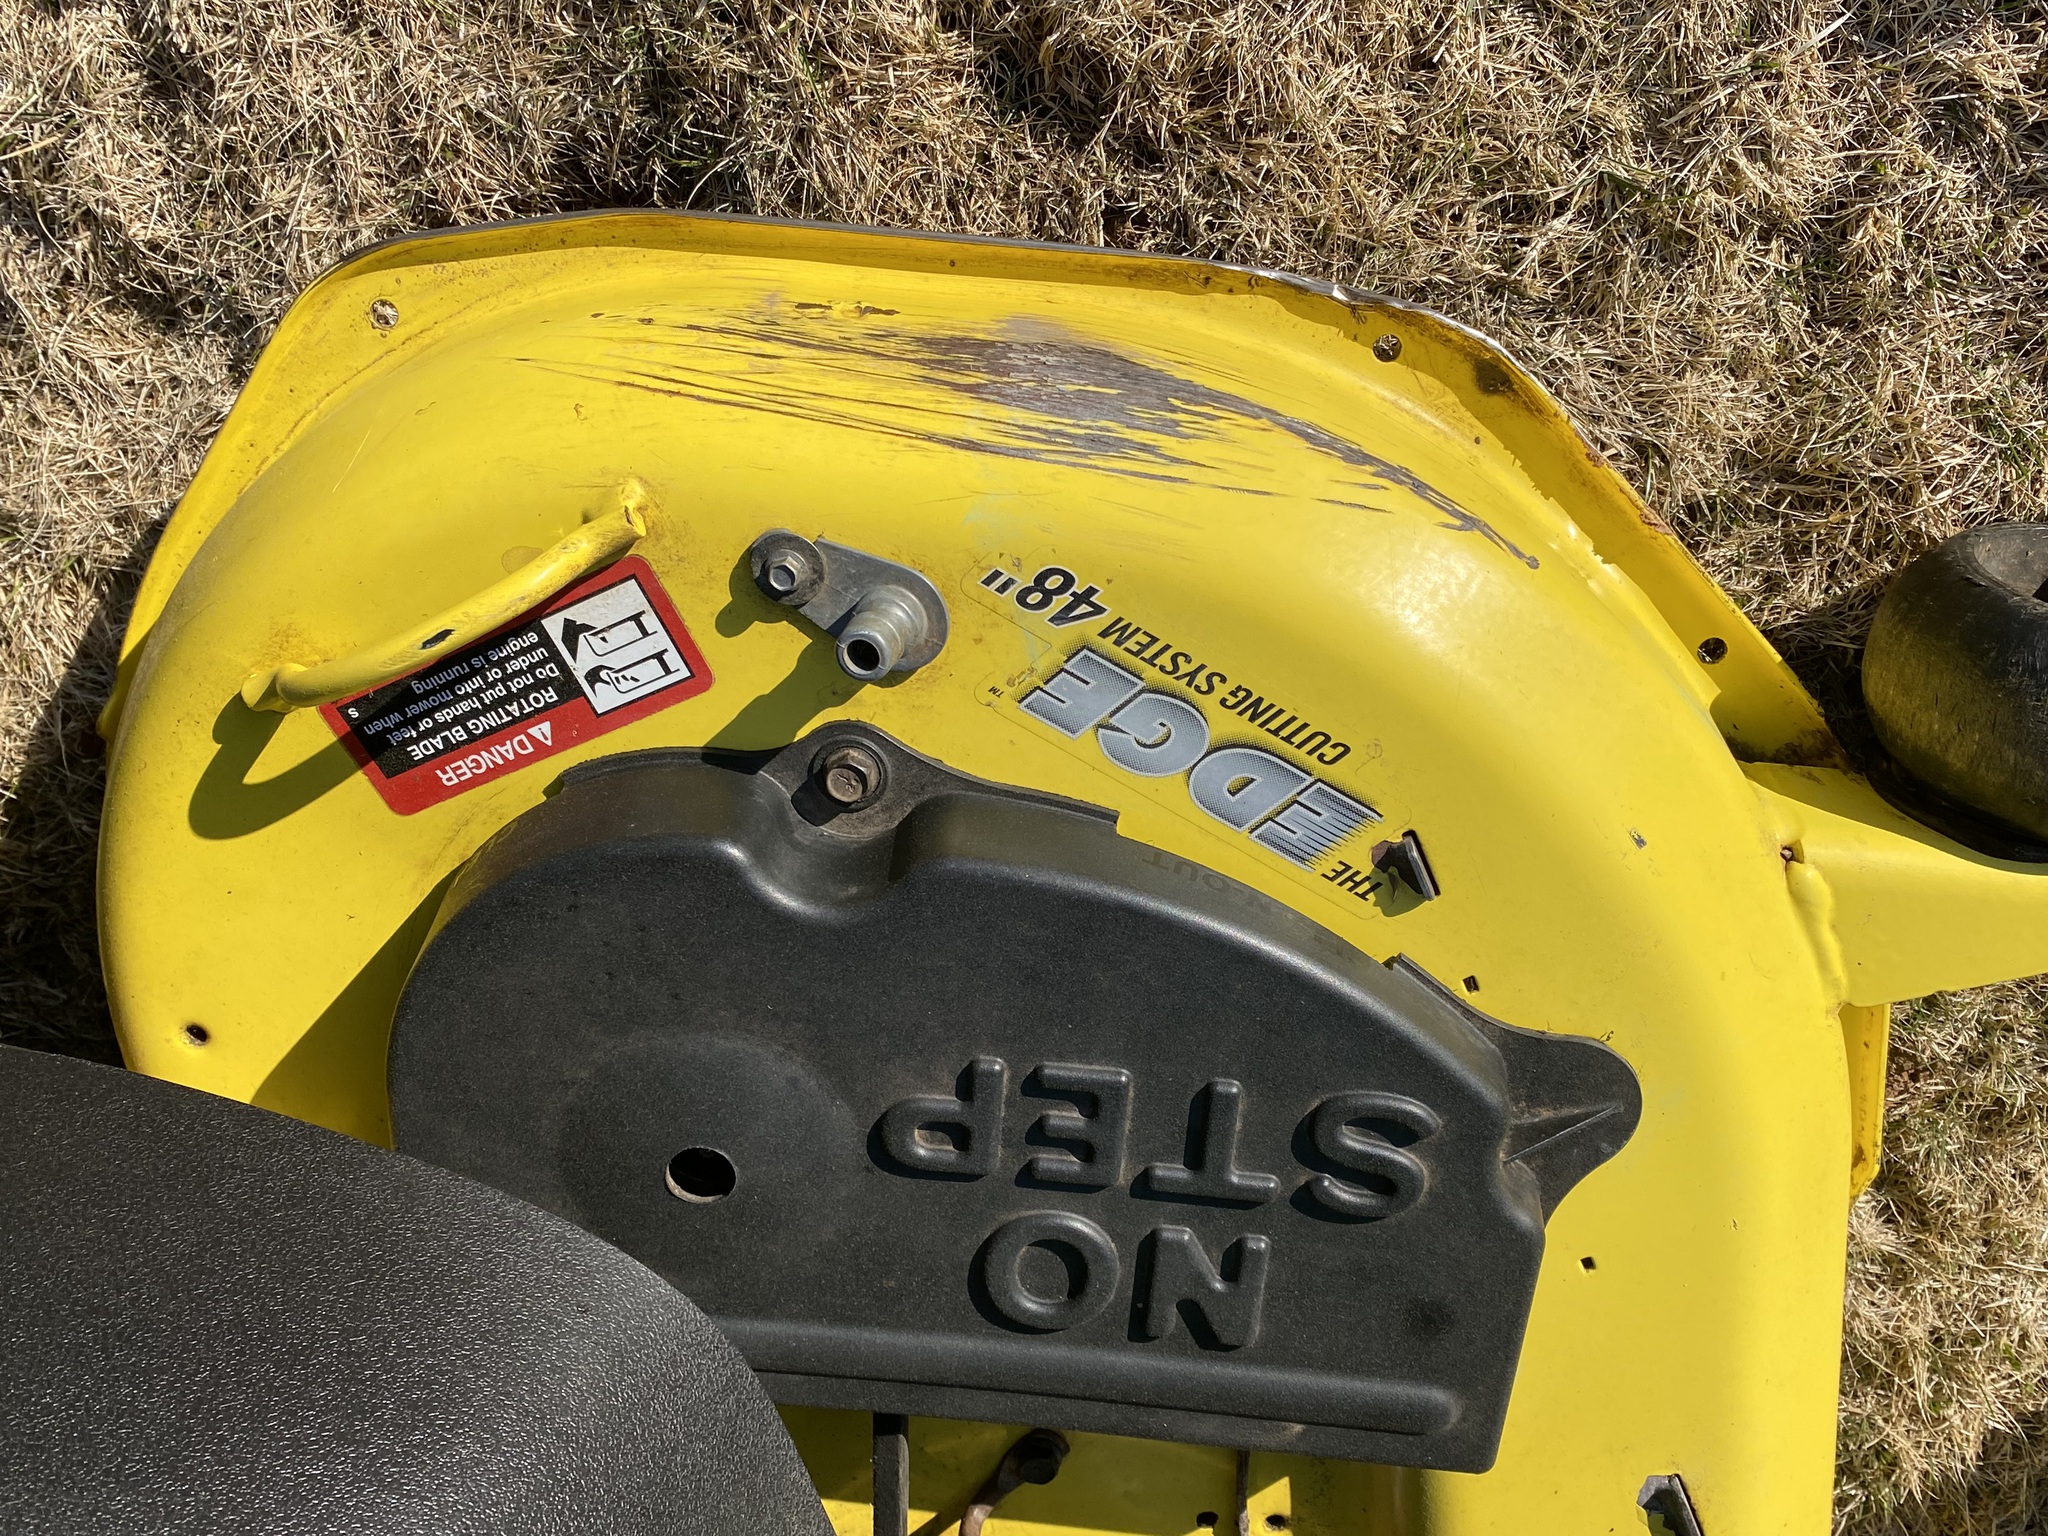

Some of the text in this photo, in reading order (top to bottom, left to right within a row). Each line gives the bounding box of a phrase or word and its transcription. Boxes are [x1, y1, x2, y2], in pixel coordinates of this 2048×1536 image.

[363, 648, 549, 735] under or into mower when
[387, 663, 560, 745] Do not put hands or feet
[411, 631, 540, 695] engine is running
[978, 565, 1351, 766] CUTTING SYSTEM 48"
[406, 686, 558, 761] ROTATING BLADE
[435, 738, 535, 787] DANGER
[1018, 645, 1383, 872] EDGE
[1321, 860, 1384, 901] THE
[872, 1055, 1442, 1220] STEP
[973, 1209, 1272, 1348] NO
